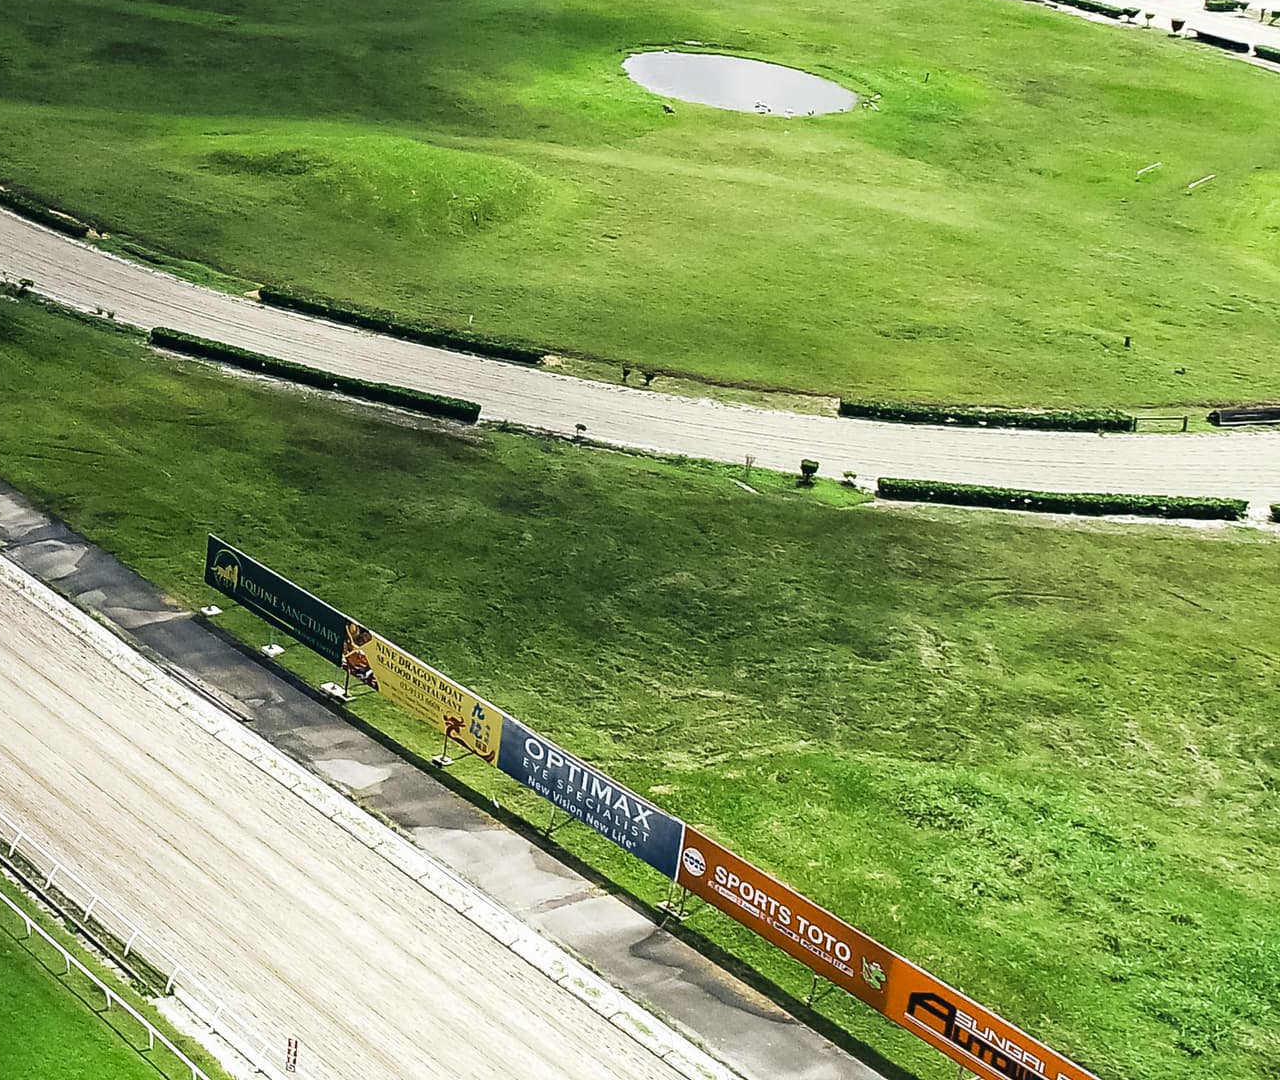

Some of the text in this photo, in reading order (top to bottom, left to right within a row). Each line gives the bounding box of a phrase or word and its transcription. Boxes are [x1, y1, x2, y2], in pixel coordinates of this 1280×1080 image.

[240, 575, 279, 608] EQUINE
[281, 601, 340, 645] SANCTUARY
[375, 642, 397, 662] NINE
[398, 657, 437, 688] DRAGON
[439, 680, 464, 702] BOAT
[376, 654, 411, 681] SEAFOOD
[412, 676, 462, 713] RESTAURANT
[522, 757, 650, 842] EYE SPECIALIST
[524, 738, 654, 831] OPTIMAX
[527, 775, 550, 796] New
[552, 790, 583, 819] Vision
[585, 813, 609, 834] New
[714, 865, 792, 926] SPORTS
[796, 915, 852, 962] TOTO
[955, 1009, 1045, 1073] SUNGAI
